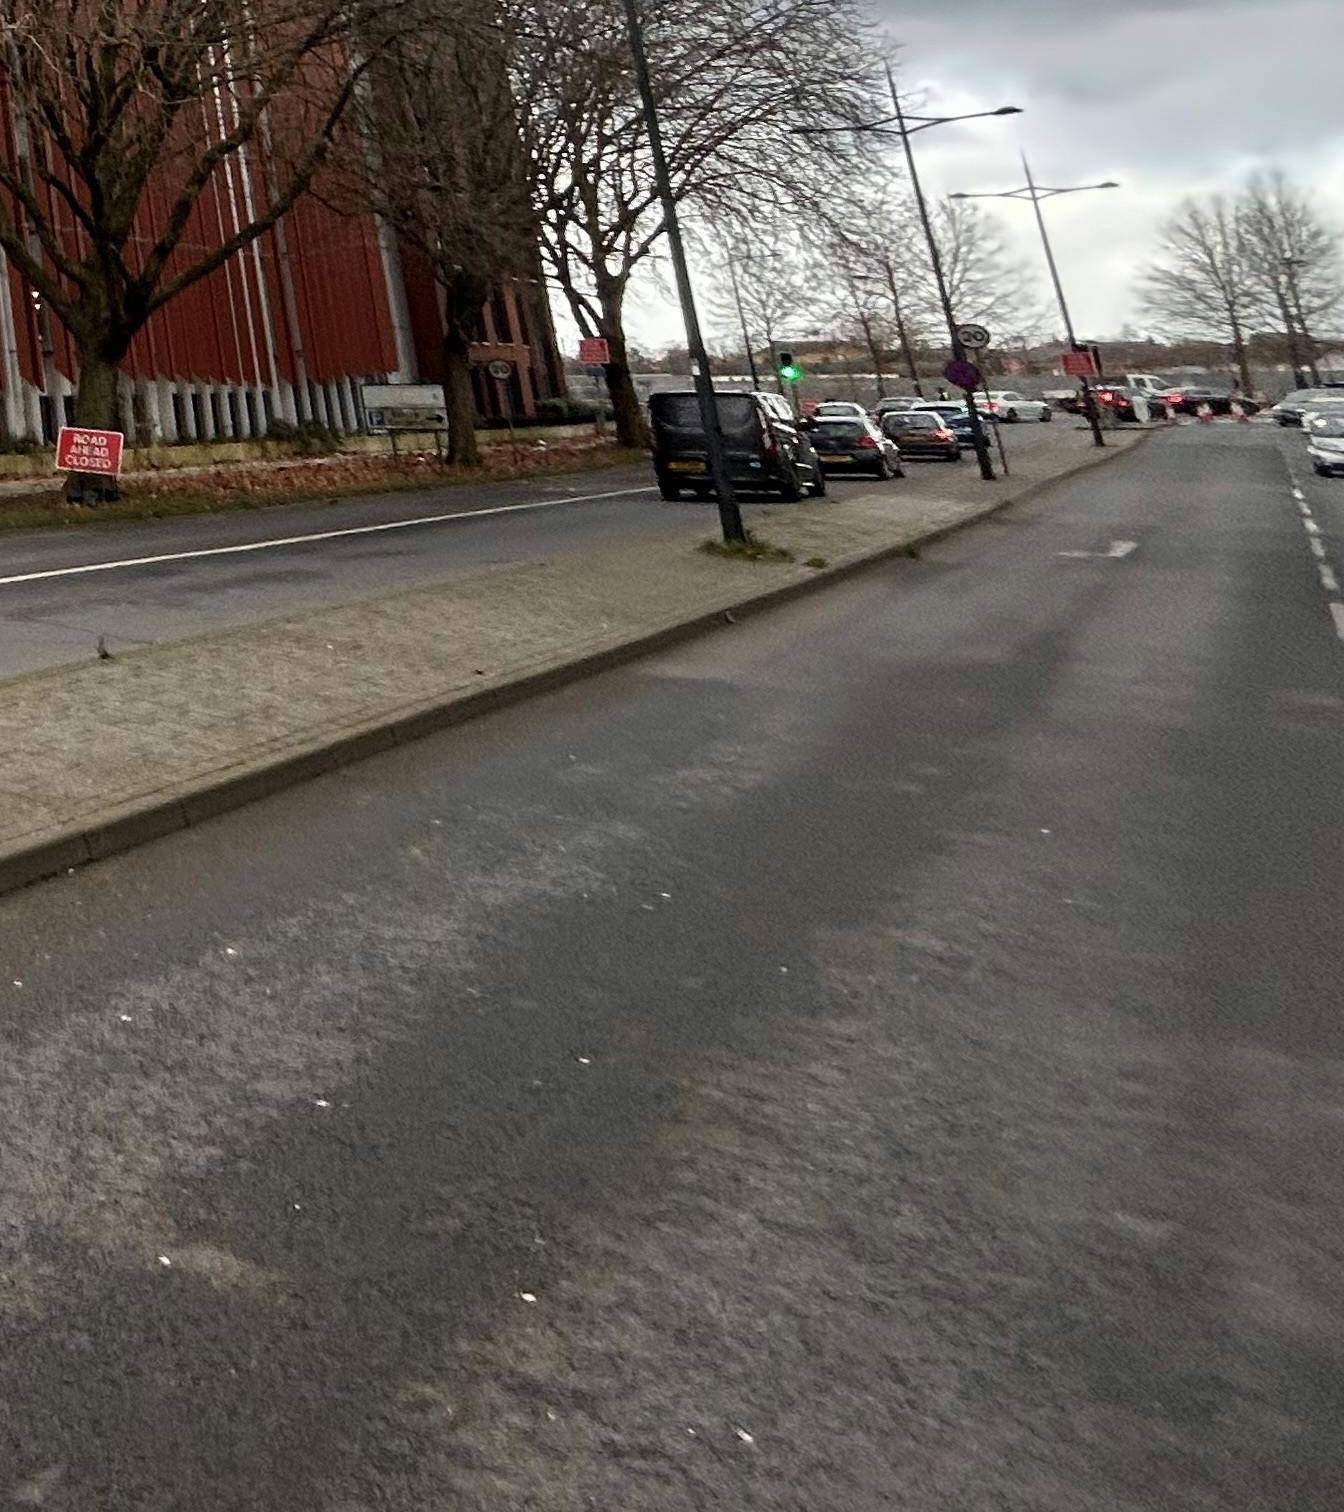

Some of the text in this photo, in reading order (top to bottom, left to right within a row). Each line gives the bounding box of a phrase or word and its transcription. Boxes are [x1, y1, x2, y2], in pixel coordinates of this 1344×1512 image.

[73, 433, 108, 446] ROAD
[69, 444, 110, 457] AHEAD
[65, 454, 112, 469] CLOSED
